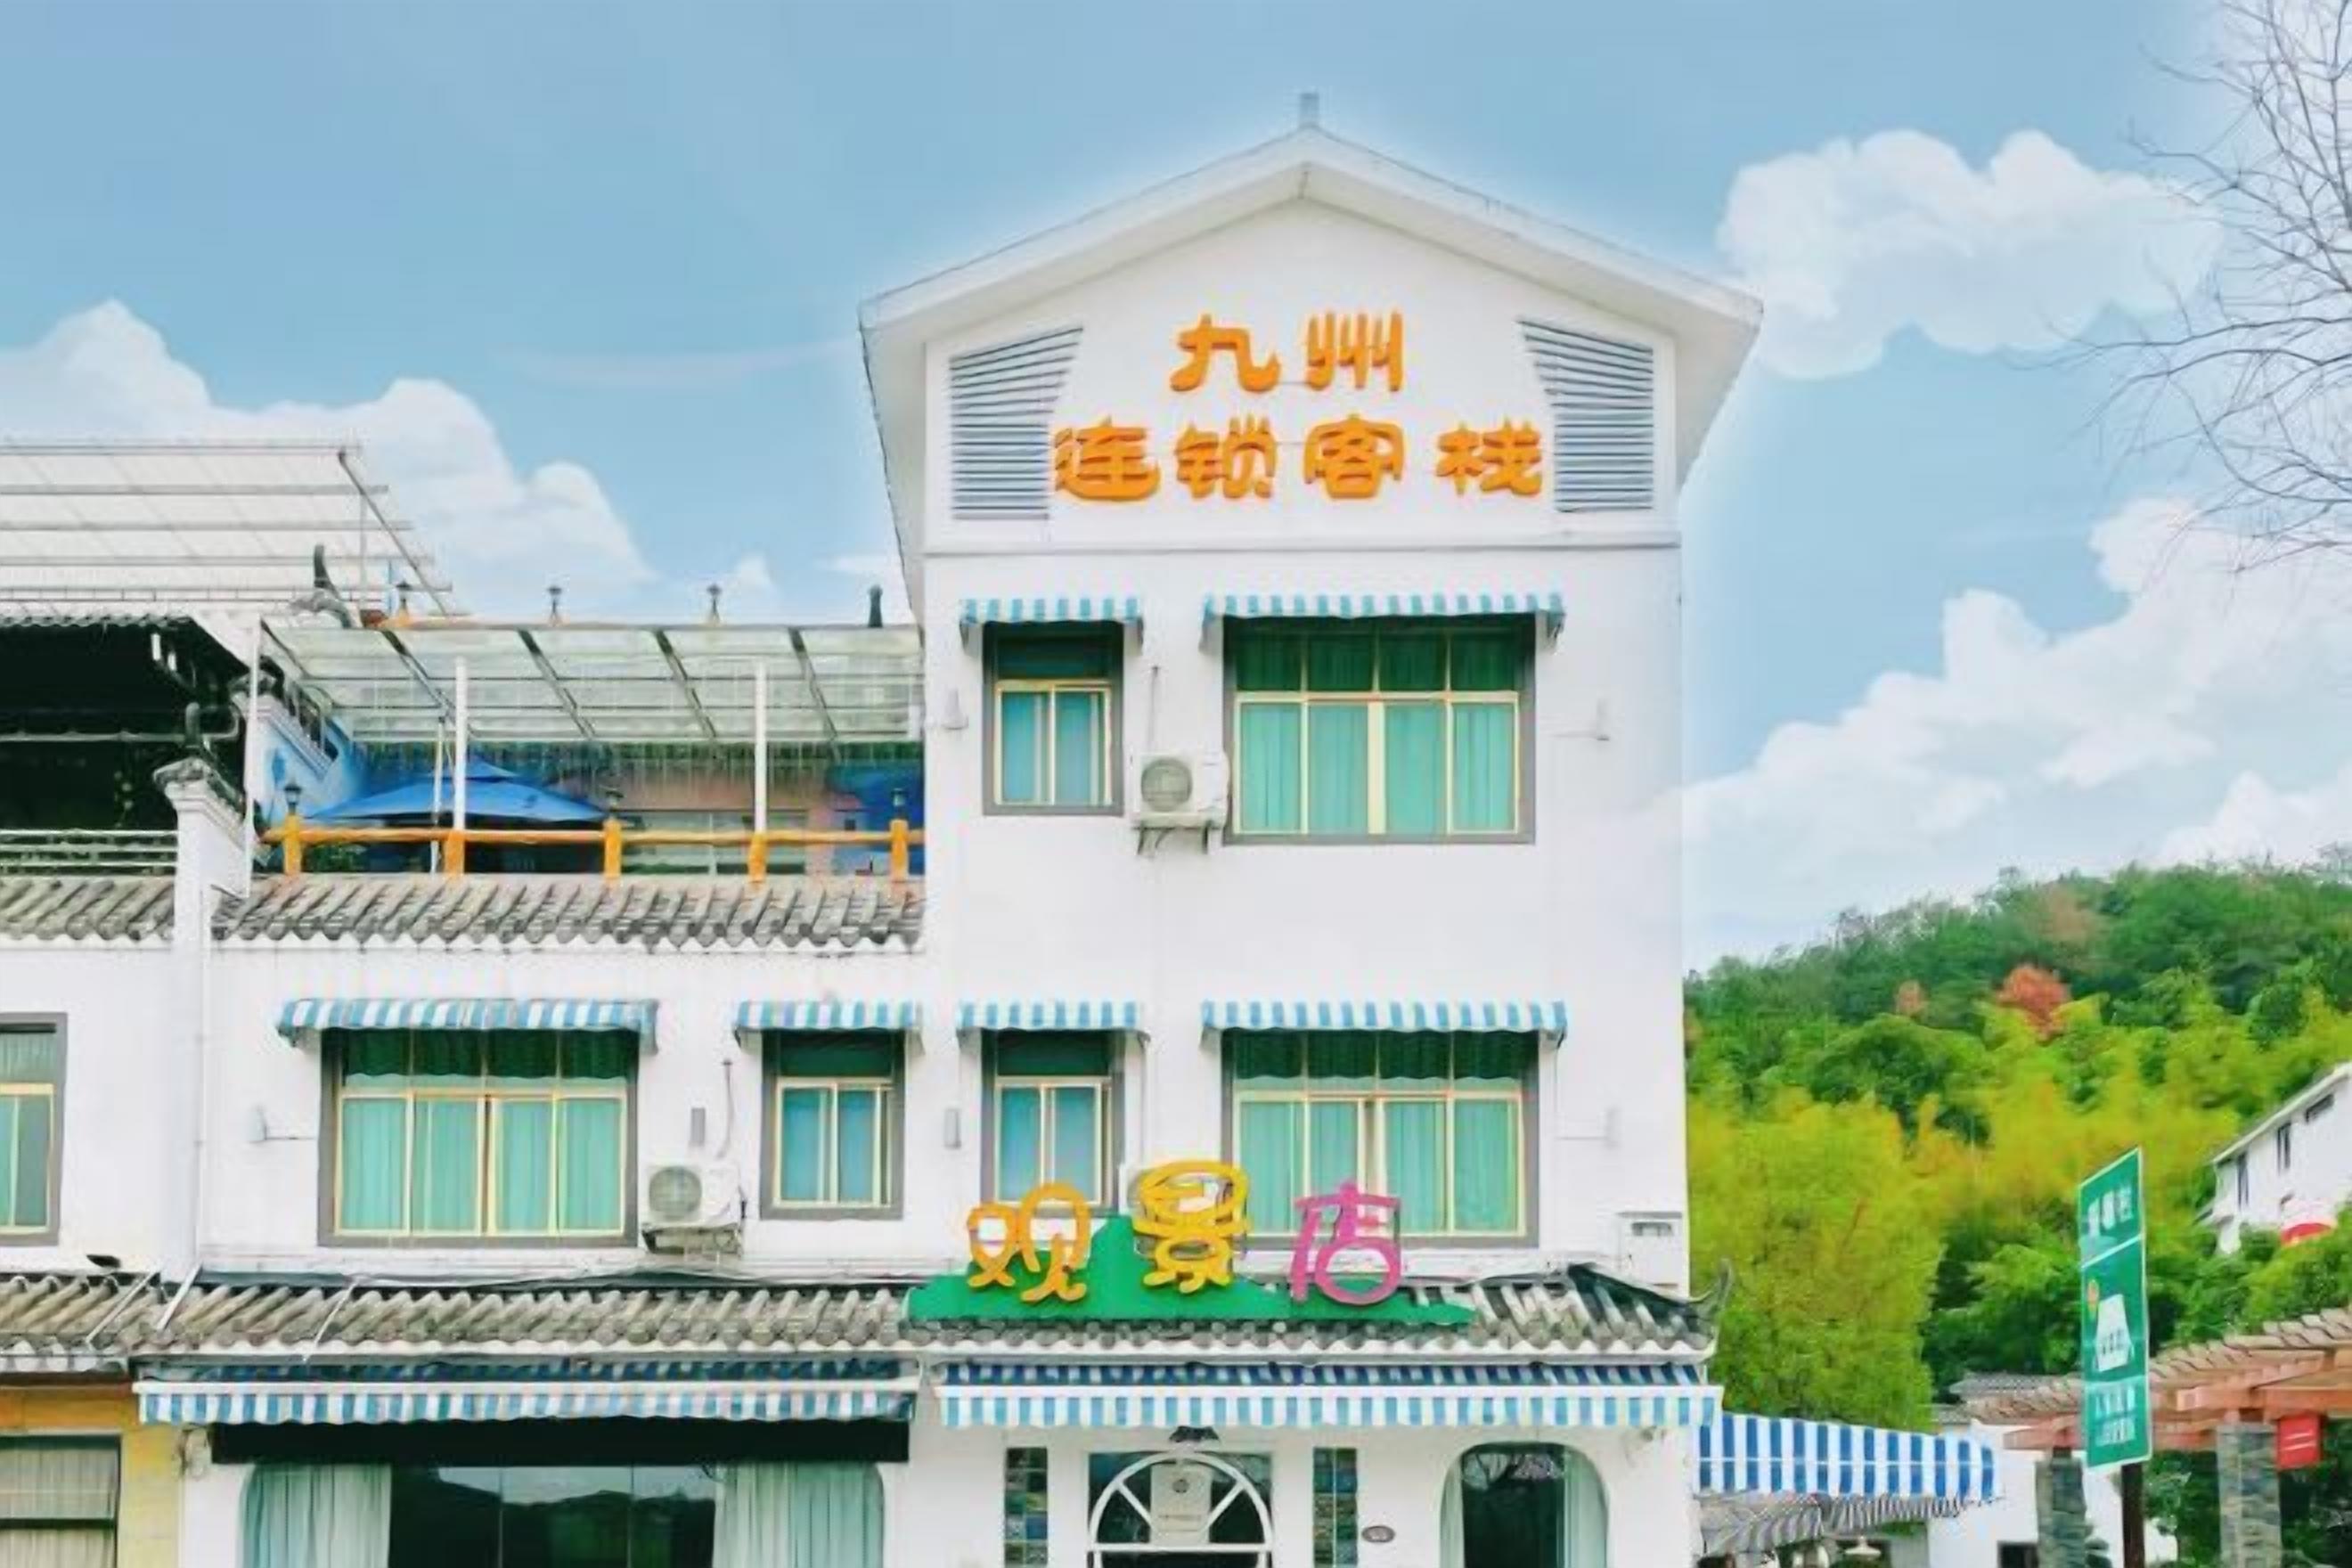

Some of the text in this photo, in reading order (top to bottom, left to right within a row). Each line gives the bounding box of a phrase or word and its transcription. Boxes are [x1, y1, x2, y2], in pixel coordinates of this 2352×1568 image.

[1170, 313, 1404, 393] 九州
[1054, 414, 1543, 502] 连锁客栈
[968, 1159, 1402, 1305] 观景店
